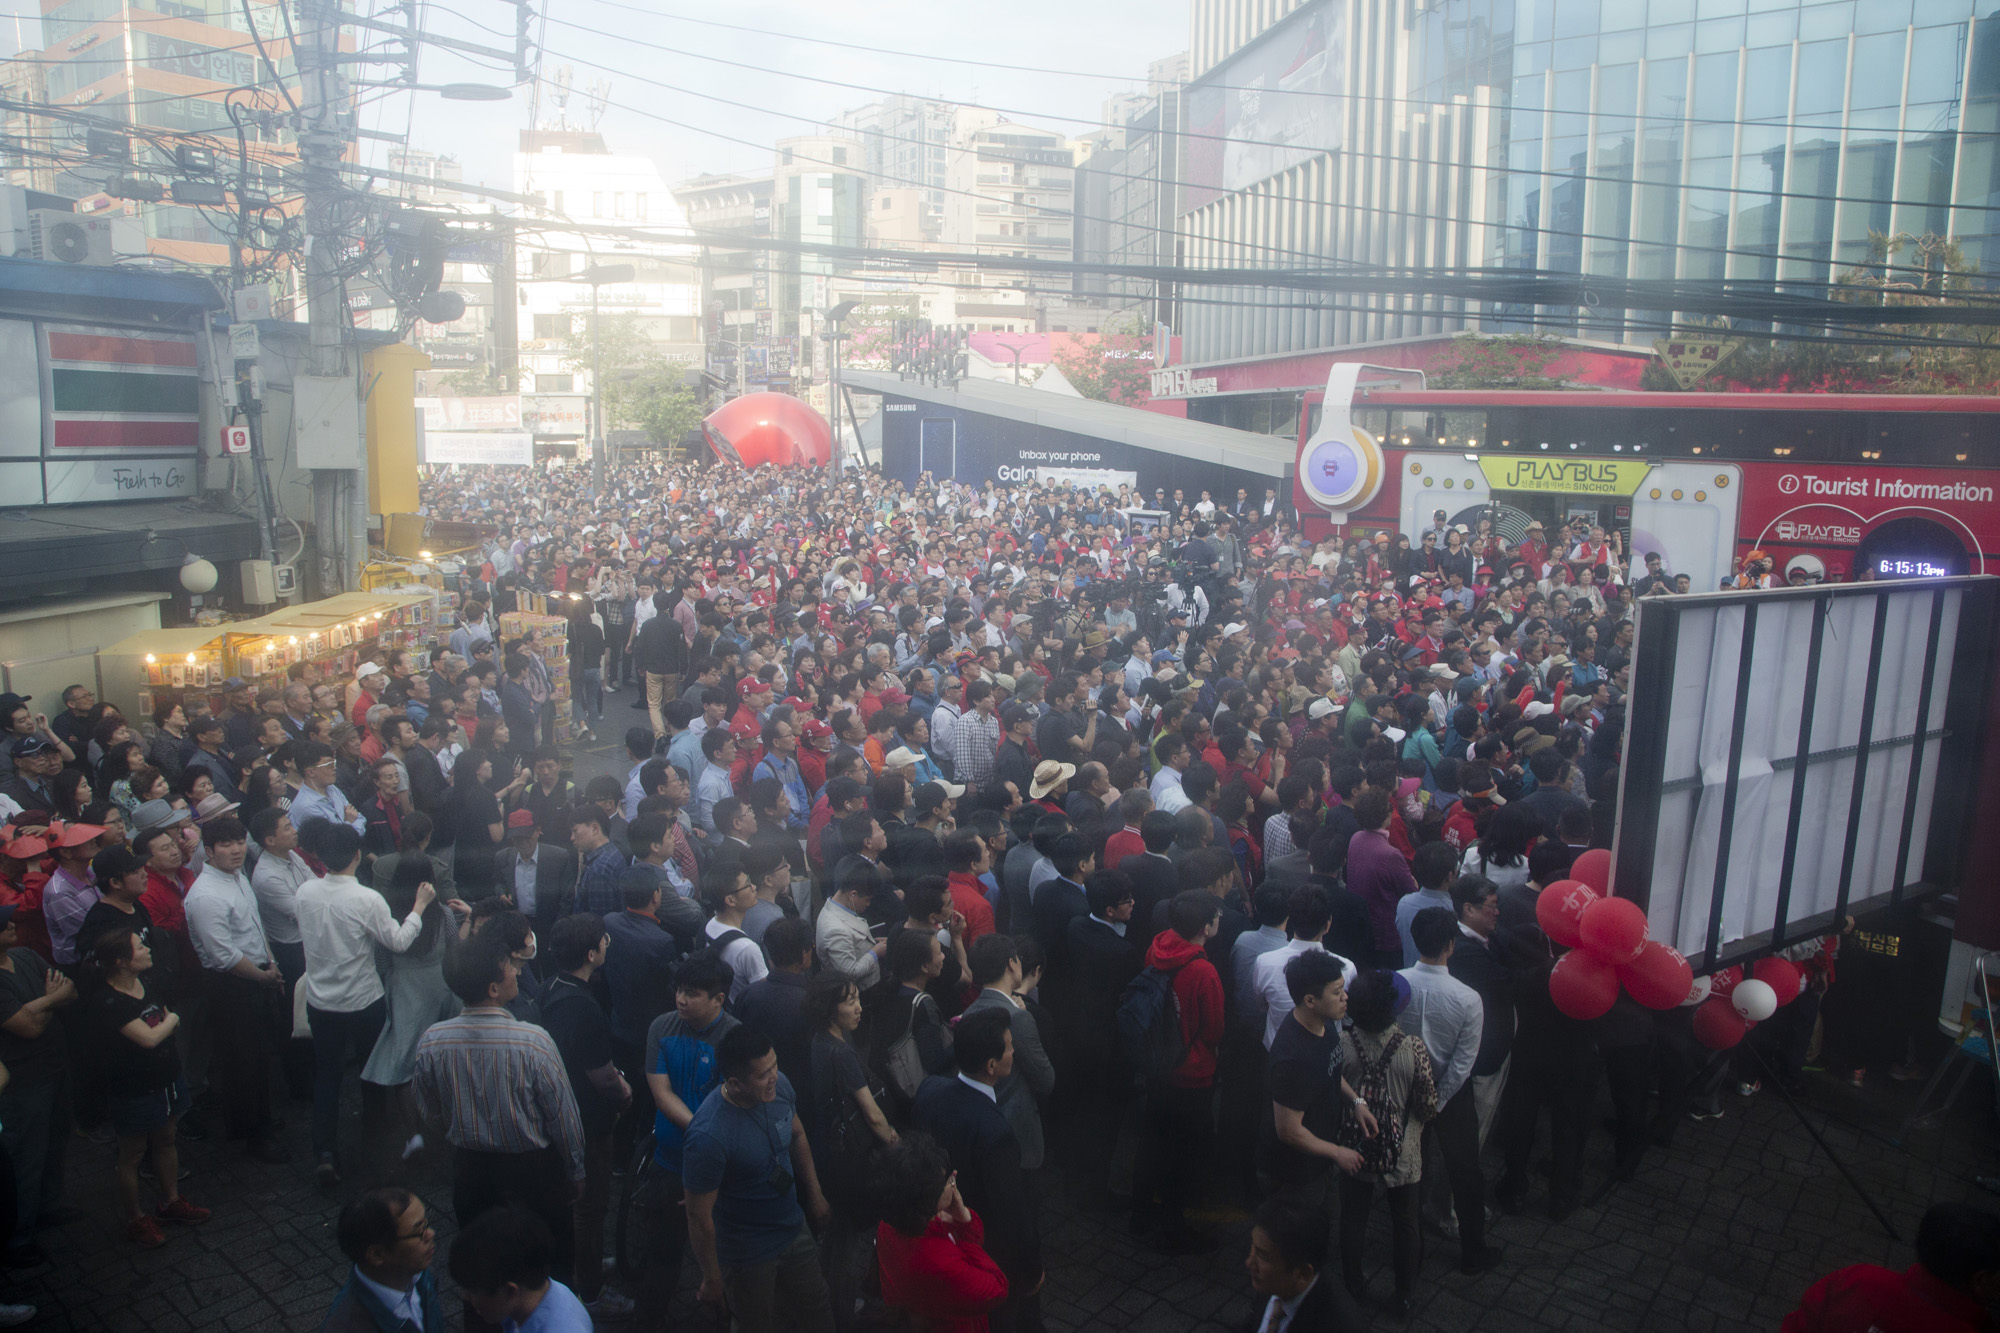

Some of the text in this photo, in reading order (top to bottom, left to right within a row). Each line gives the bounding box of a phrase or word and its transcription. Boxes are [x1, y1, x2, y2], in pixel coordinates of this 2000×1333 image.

[885, 404, 916, 412] SAMSUNG
[1019, 449, 1101, 463] Unbox your phone
[113, 467, 185, 491] Fresh to Go
[998, 464, 1037, 482] Gala
[1507, 461, 1617, 487] PLAYBUS
[1521, 480, 1616, 492] 신촌플레이버스 SINCHON
[1803, 475, 1993, 502] Tourist Information
[1792, 524, 1861, 540] PLAYBUS
[743, 685, 749, 693] 2
[734, 732, 741, 740] 2
[807, 729, 813, 737] 2
